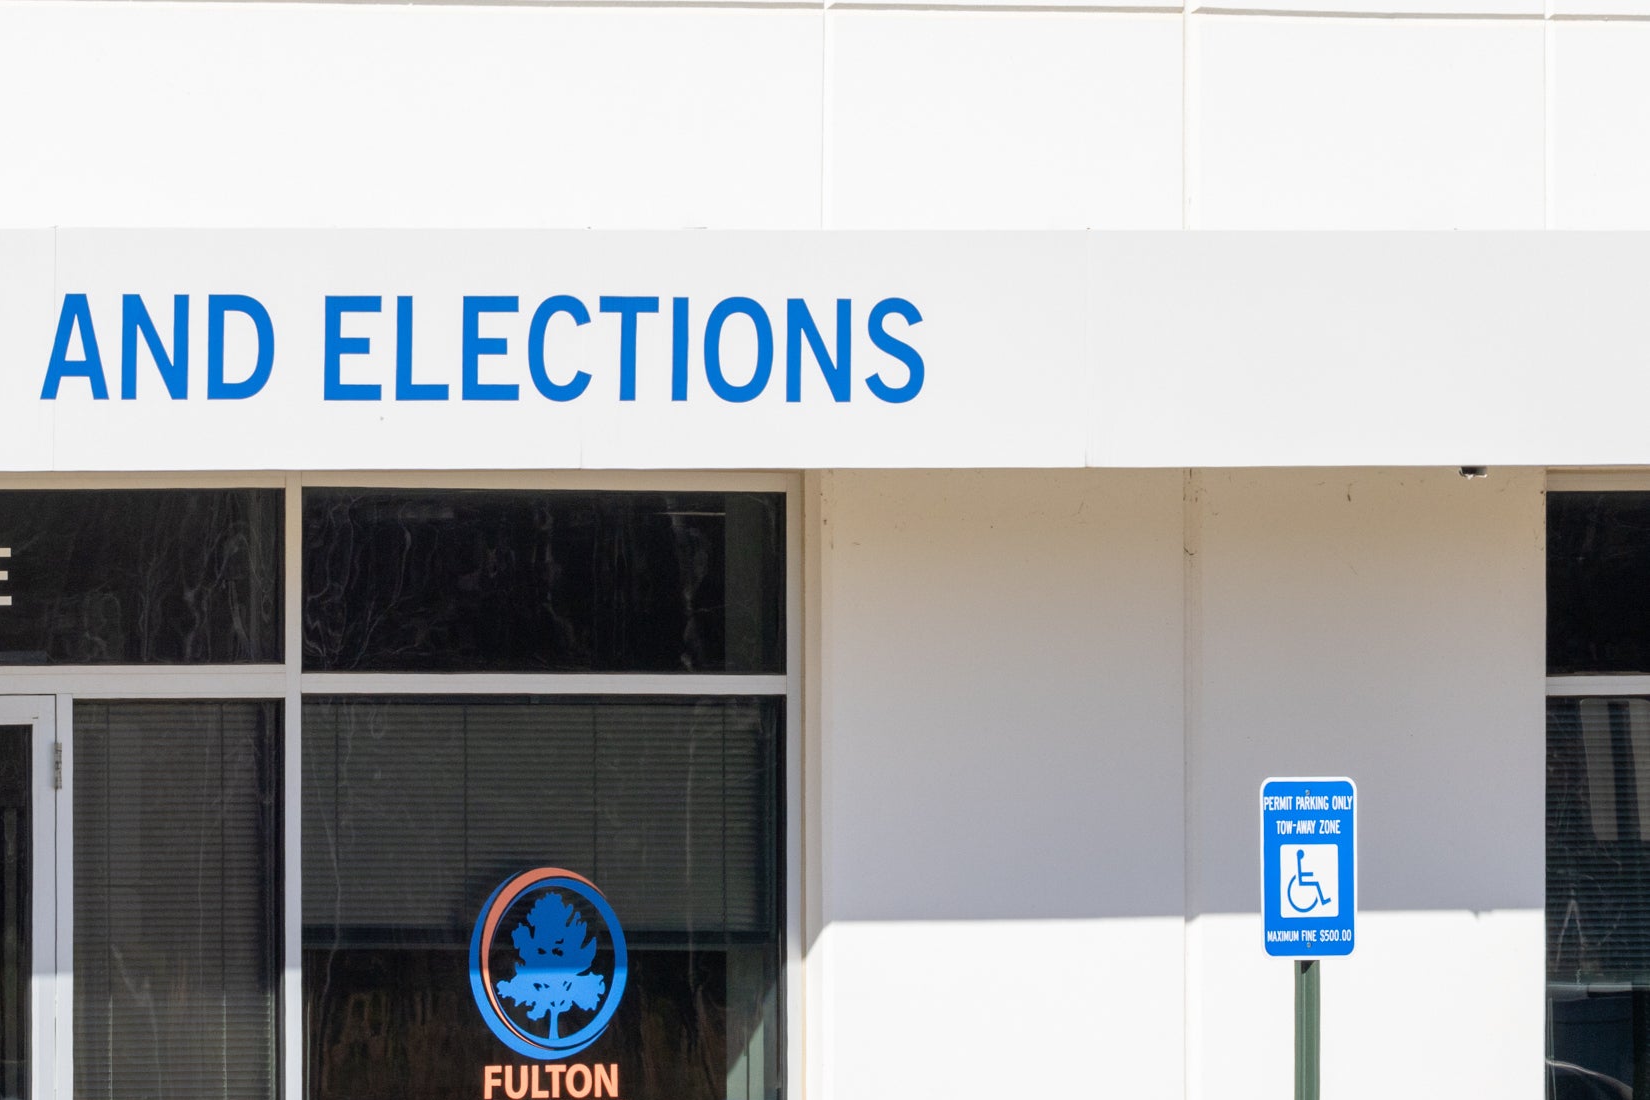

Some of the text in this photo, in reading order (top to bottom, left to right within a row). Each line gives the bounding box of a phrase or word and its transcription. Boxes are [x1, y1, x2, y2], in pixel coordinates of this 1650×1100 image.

[40, 292, 275, 401] AND
[323, 294, 926, 403] ELECTIONS
[1264, 795, 1353, 811] PERMIT PARKING ONLY
[1276, 820, 1341, 835] TOW-AWAY ZONE
[1267, 929, 1352, 942] MAXIMUM FINE $500.00
[484, 1063, 619, 1100] FULTON
